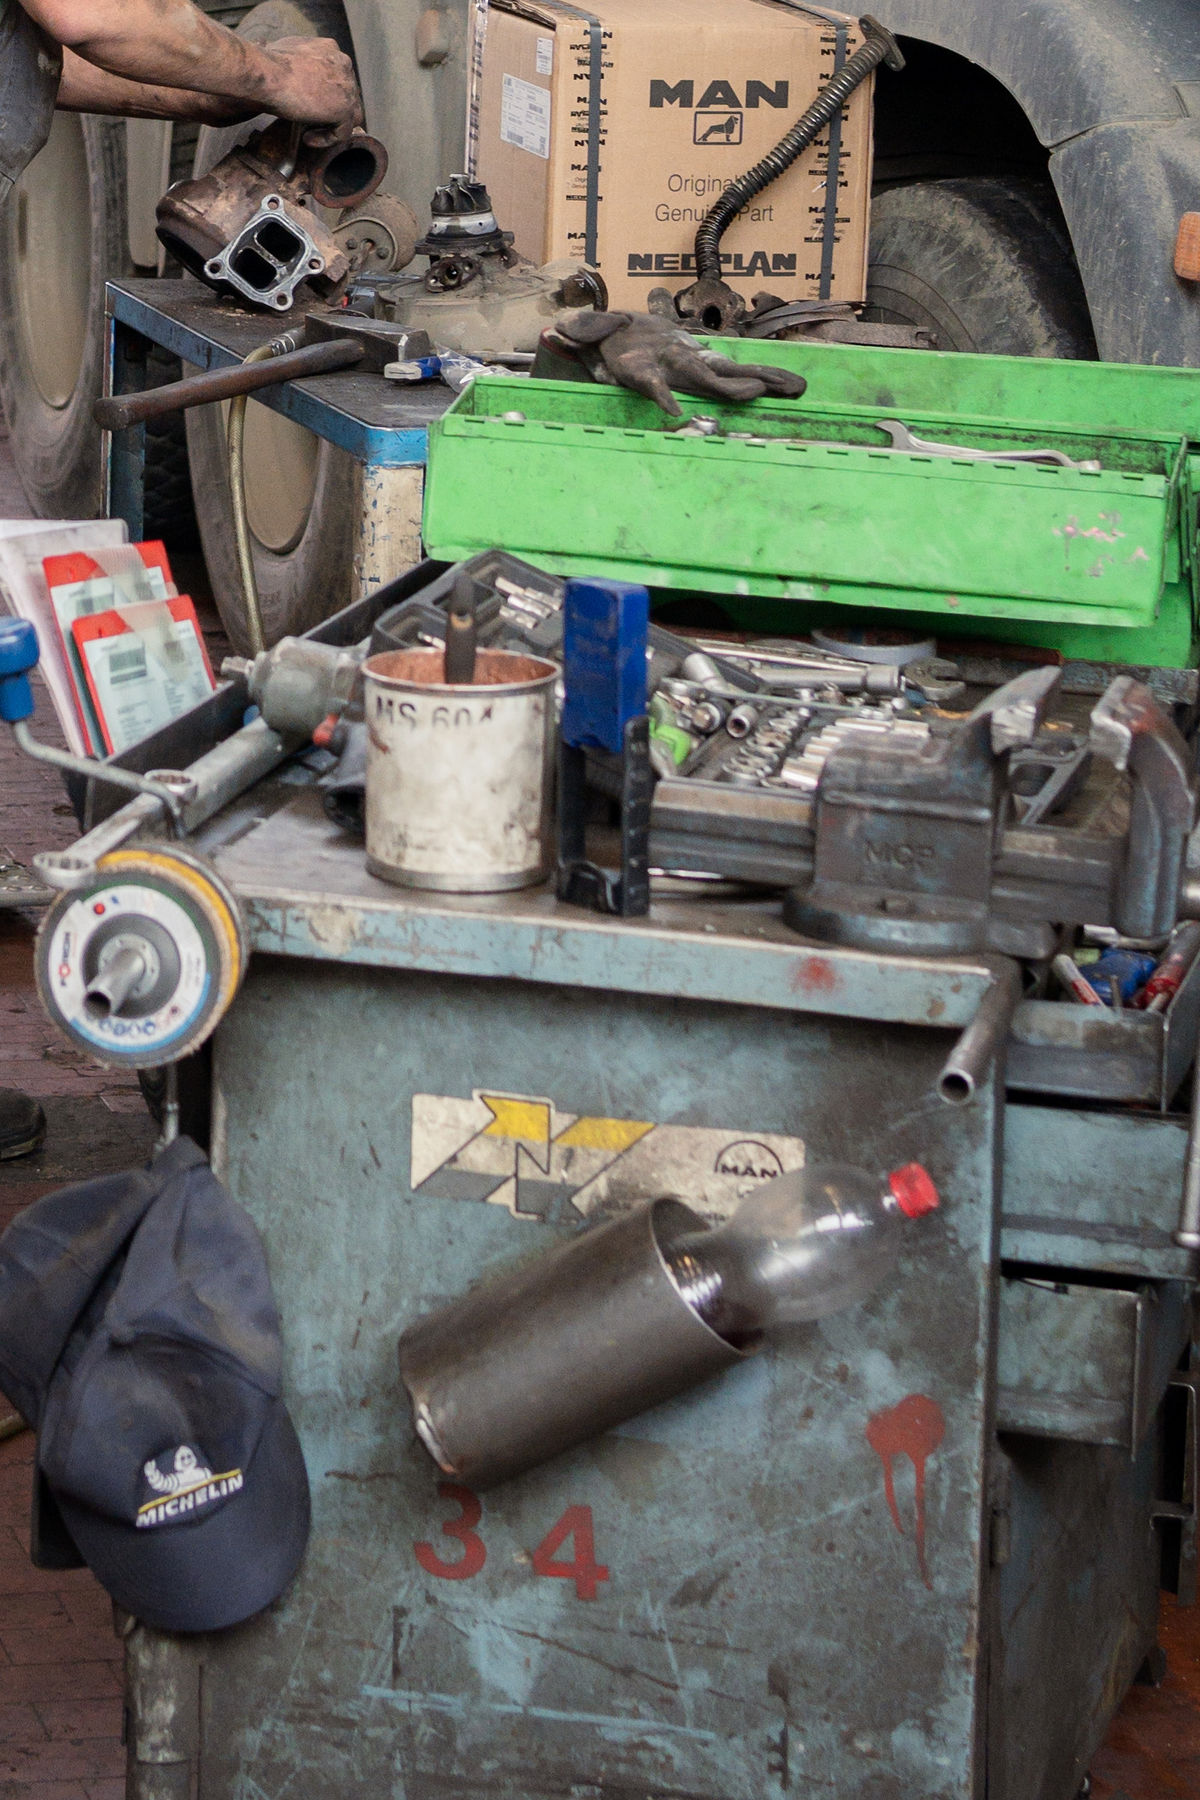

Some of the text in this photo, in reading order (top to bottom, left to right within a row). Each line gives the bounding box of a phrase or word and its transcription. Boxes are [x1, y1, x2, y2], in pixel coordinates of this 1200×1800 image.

[649, 79, 789, 109] MAN
[655, 203, 775, 222] Genui Part
[720, 1163, 778, 1179] MAN
[135, 1473, 244, 1528] MICHELIN
